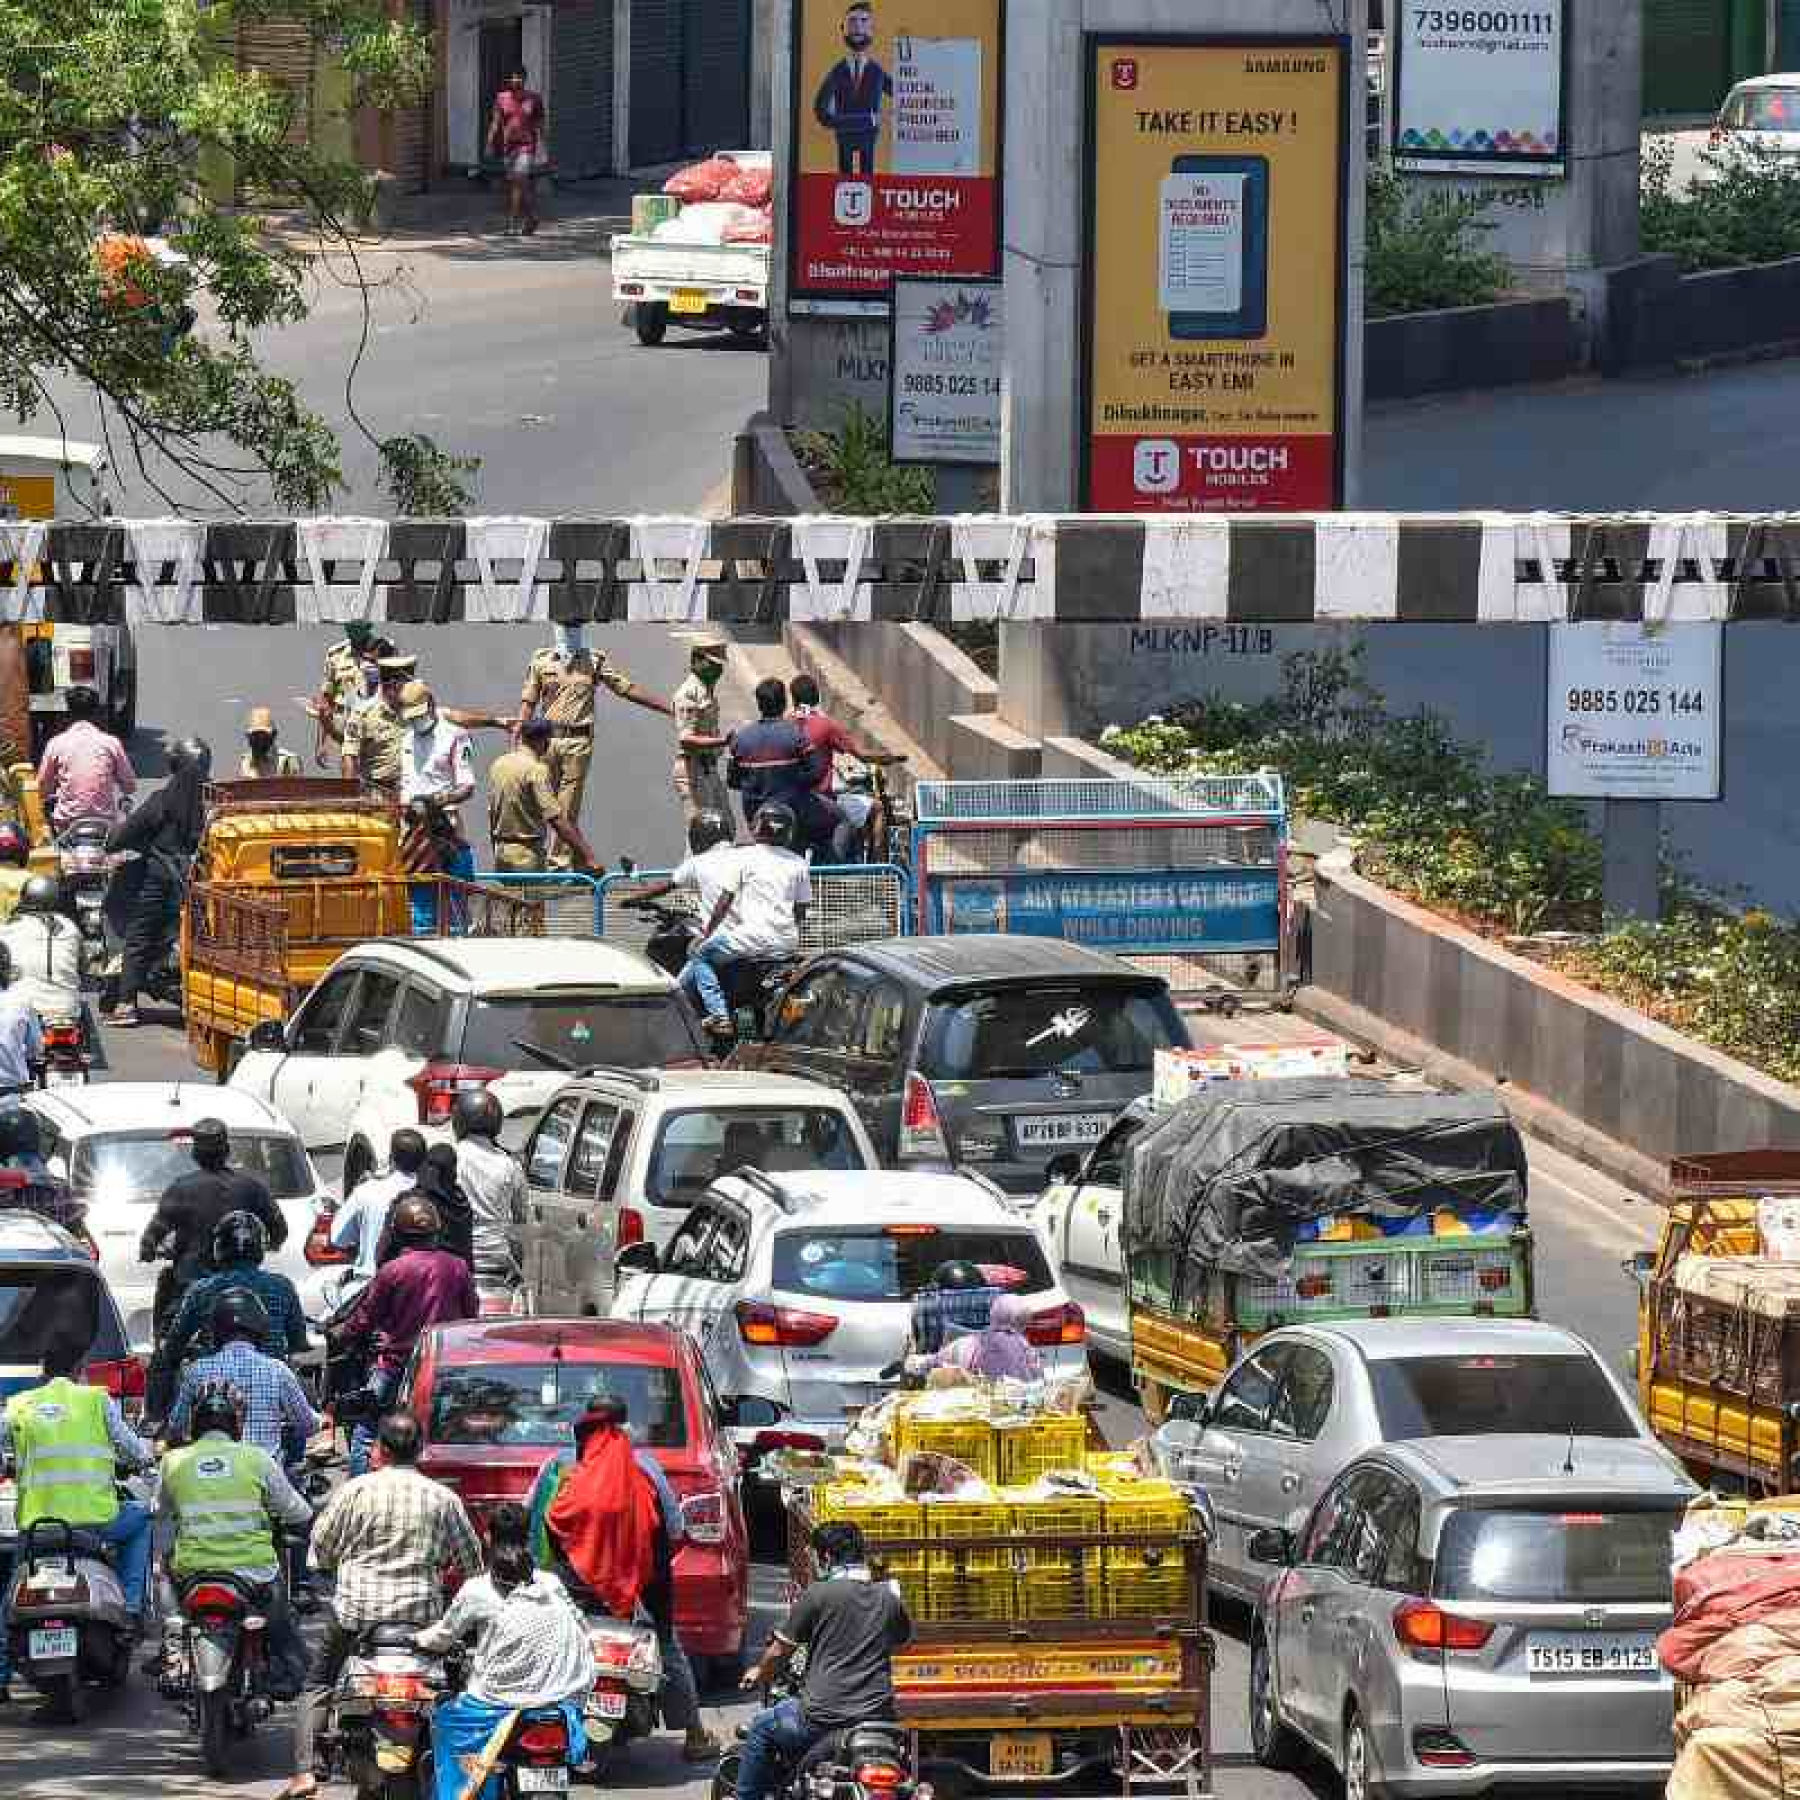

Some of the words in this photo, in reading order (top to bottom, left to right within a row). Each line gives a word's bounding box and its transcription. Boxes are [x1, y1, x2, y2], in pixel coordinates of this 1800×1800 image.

[1412, 10, 1552, 34] 7396001111
[1245, 56, 1327, 73] SAMSUNG
[1136, 111, 1192, 132] TAKE
[1201, 111, 1218, 132] IT
[1224, 111, 1282, 133] EASY
[881, 188, 960, 208] TOUCH
[1131, 353, 1157, 368] GET
[1160, 353, 1171, 368] A
[1279, 352, 1295, 368] IN
[1169, 372, 1215, 390] EASY
[1222, 372, 1255, 390] EMI
[1187, 447, 1289, 471] TOUCH
[1567, 688, 1618, 713] 9885
[1623, 689, 1659, 714] 025
[1668, 690, 1703, 714] 144
